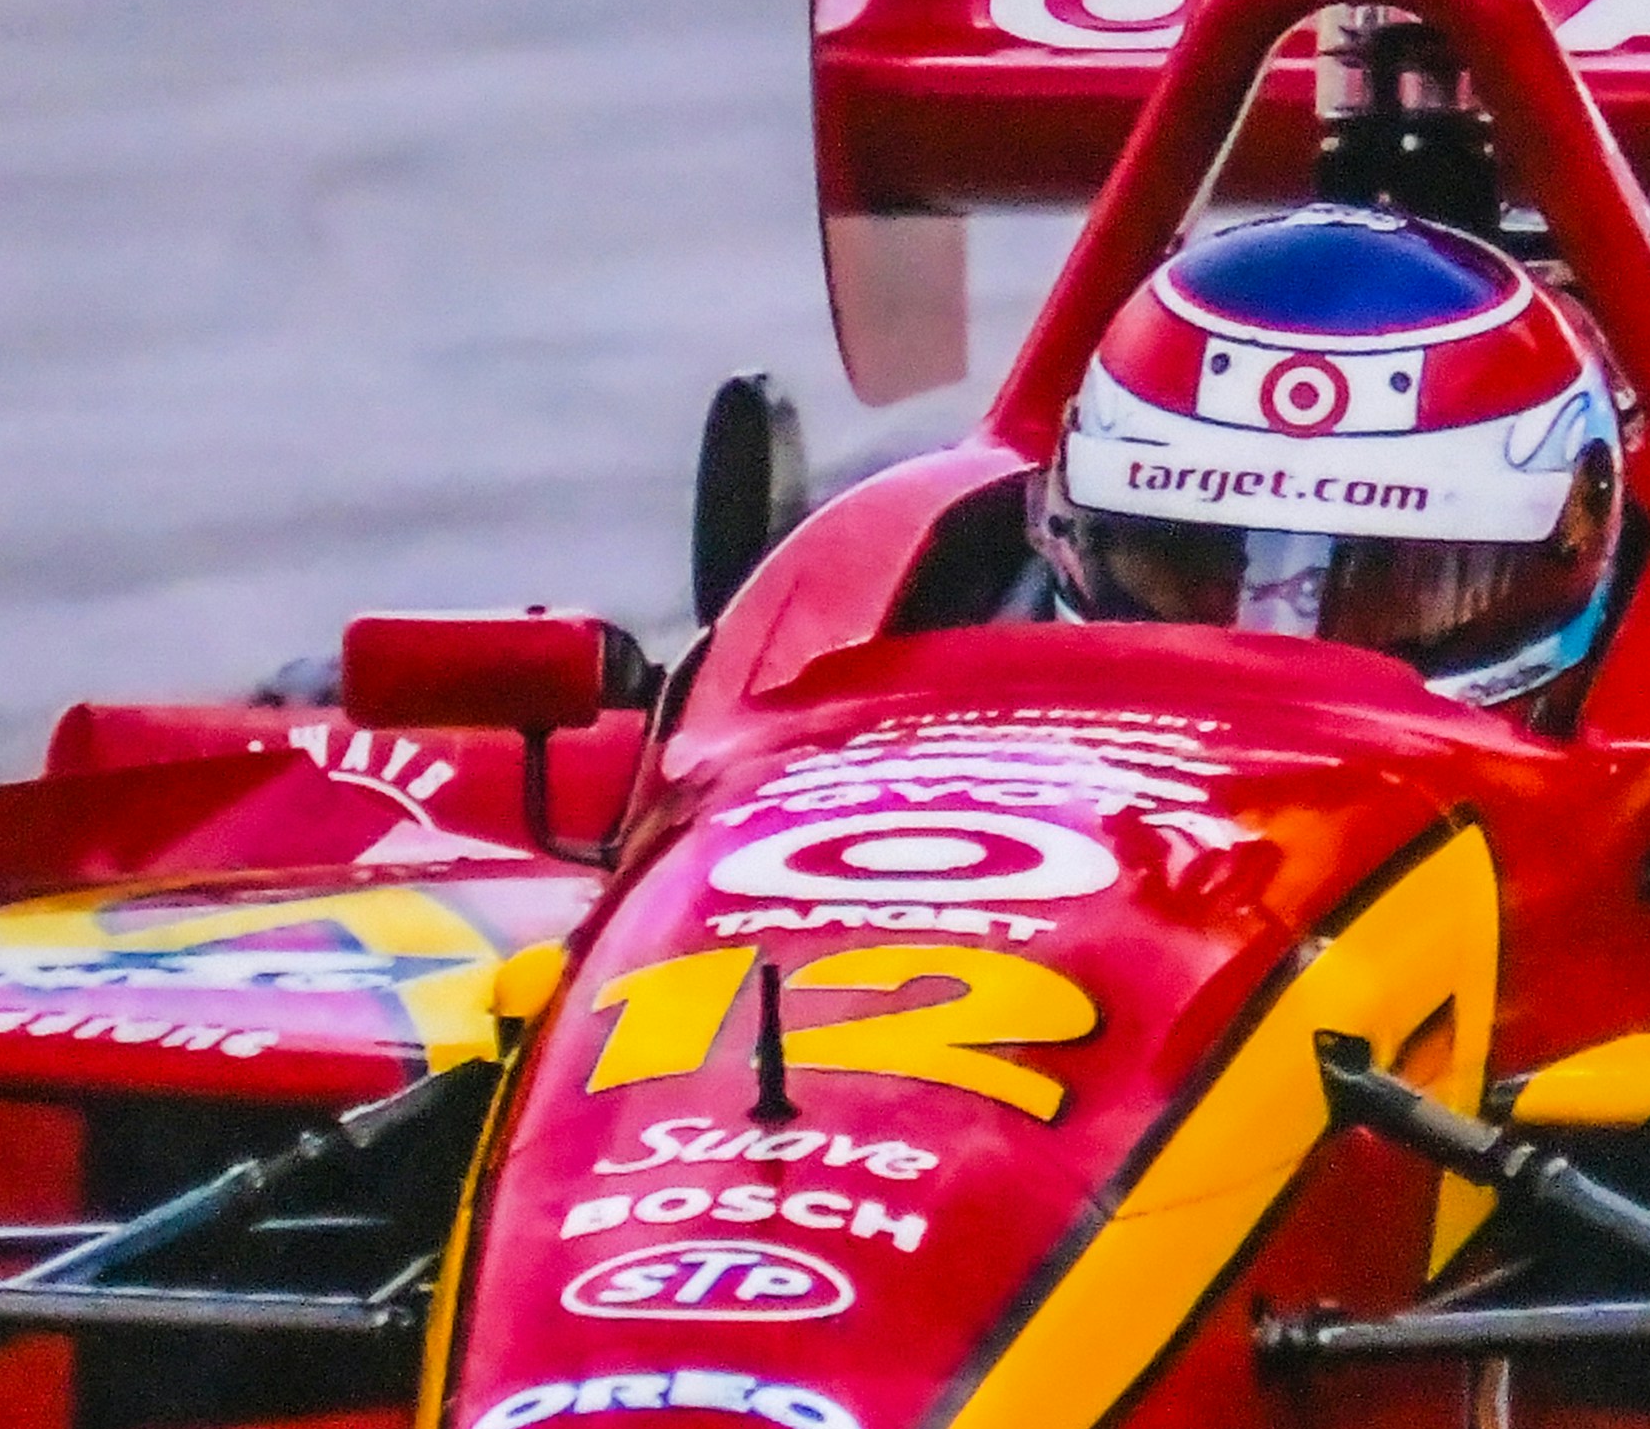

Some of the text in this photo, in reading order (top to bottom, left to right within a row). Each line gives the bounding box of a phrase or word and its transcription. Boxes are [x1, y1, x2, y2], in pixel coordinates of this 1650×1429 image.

[1127, 459, 1431, 513] target.com
[705, 904, 1057, 941] TARGET
[585, 944, 1105, 1123] 12
[593, 1117, 941, 1180] Suave
[559, 1185, 929, 1254] BOSCH
[597, 1250, 817, 1306] STP
